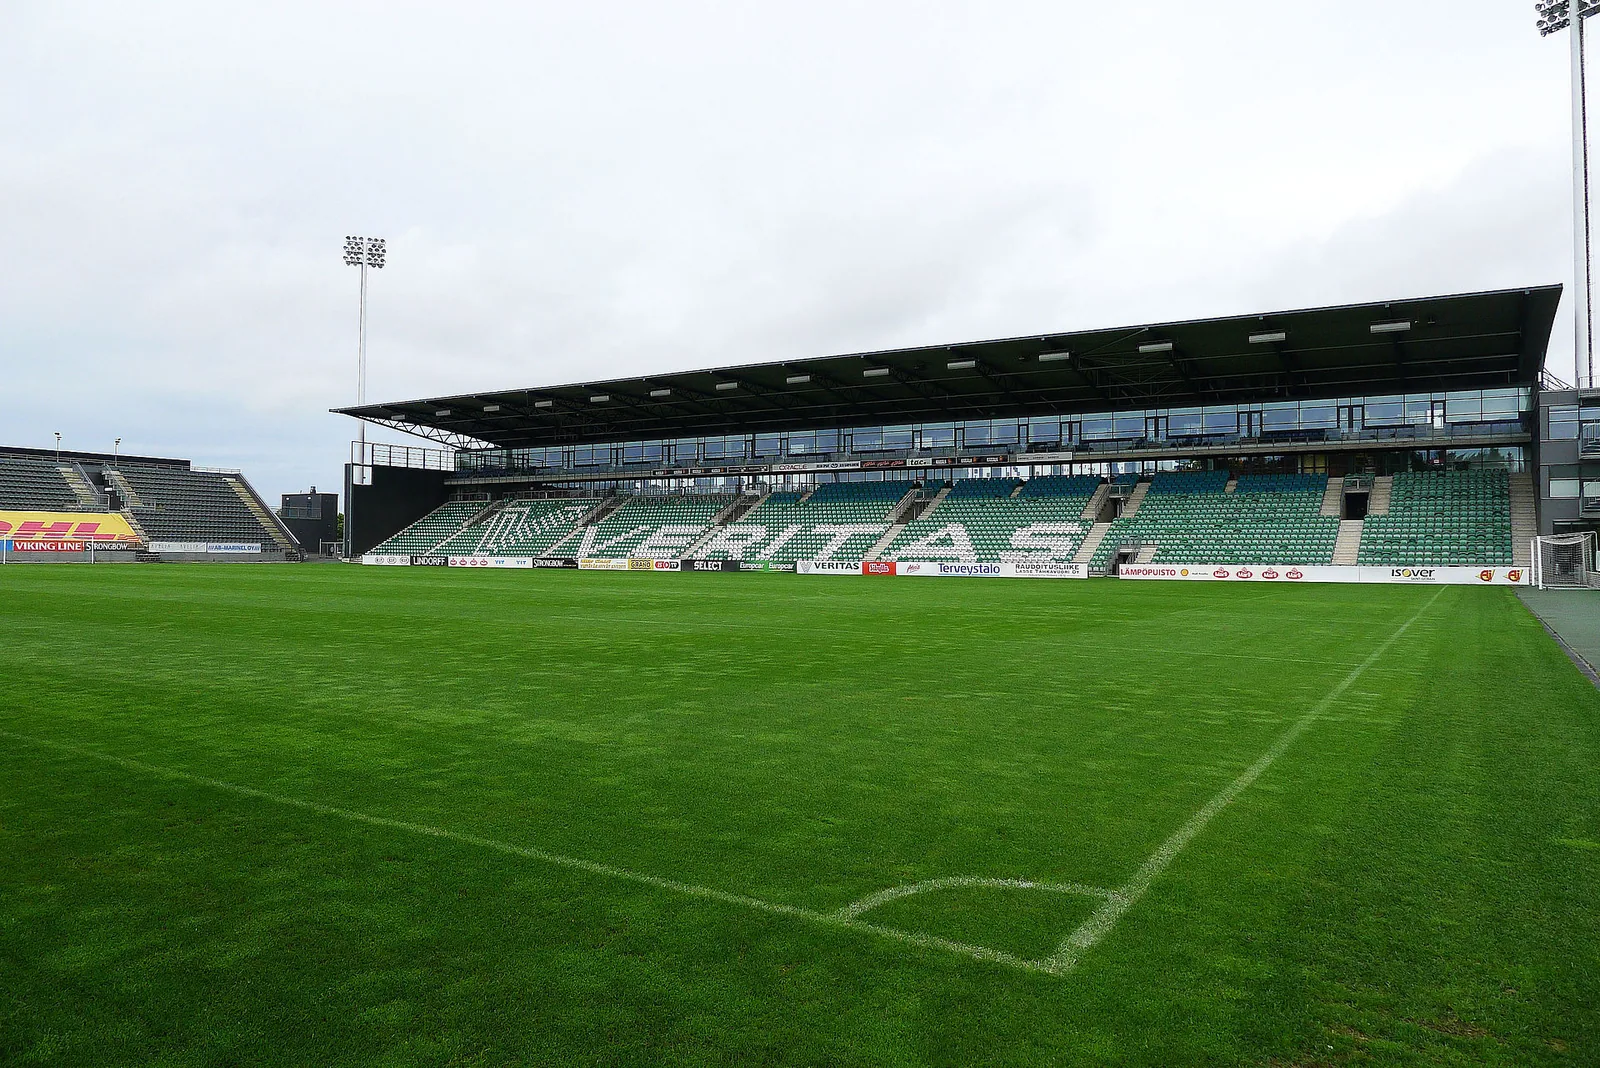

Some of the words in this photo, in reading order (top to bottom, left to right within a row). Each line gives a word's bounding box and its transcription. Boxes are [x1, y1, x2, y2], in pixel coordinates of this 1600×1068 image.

[0, 521, 116, 540] HL
[15, 542, 56, 550] VIKING
[58, 542, 82, 550] LINE
[576, 522, 1085, 563] VERITAS
[413, 557, 446, 566] LINDORFF
[534, 558, 564, 568] STRONGBOW
[693, 561, 722, 571] SELECT
[740, 561, 764, 570] Europcar
[768, 562, 794, 570] Europcar
[813, 562, 860, 570] VERITAS
[938, 563, 1000, 575] Terveystalo
[1120, 567, 1176, 576] LÄMPÖPUISTO
